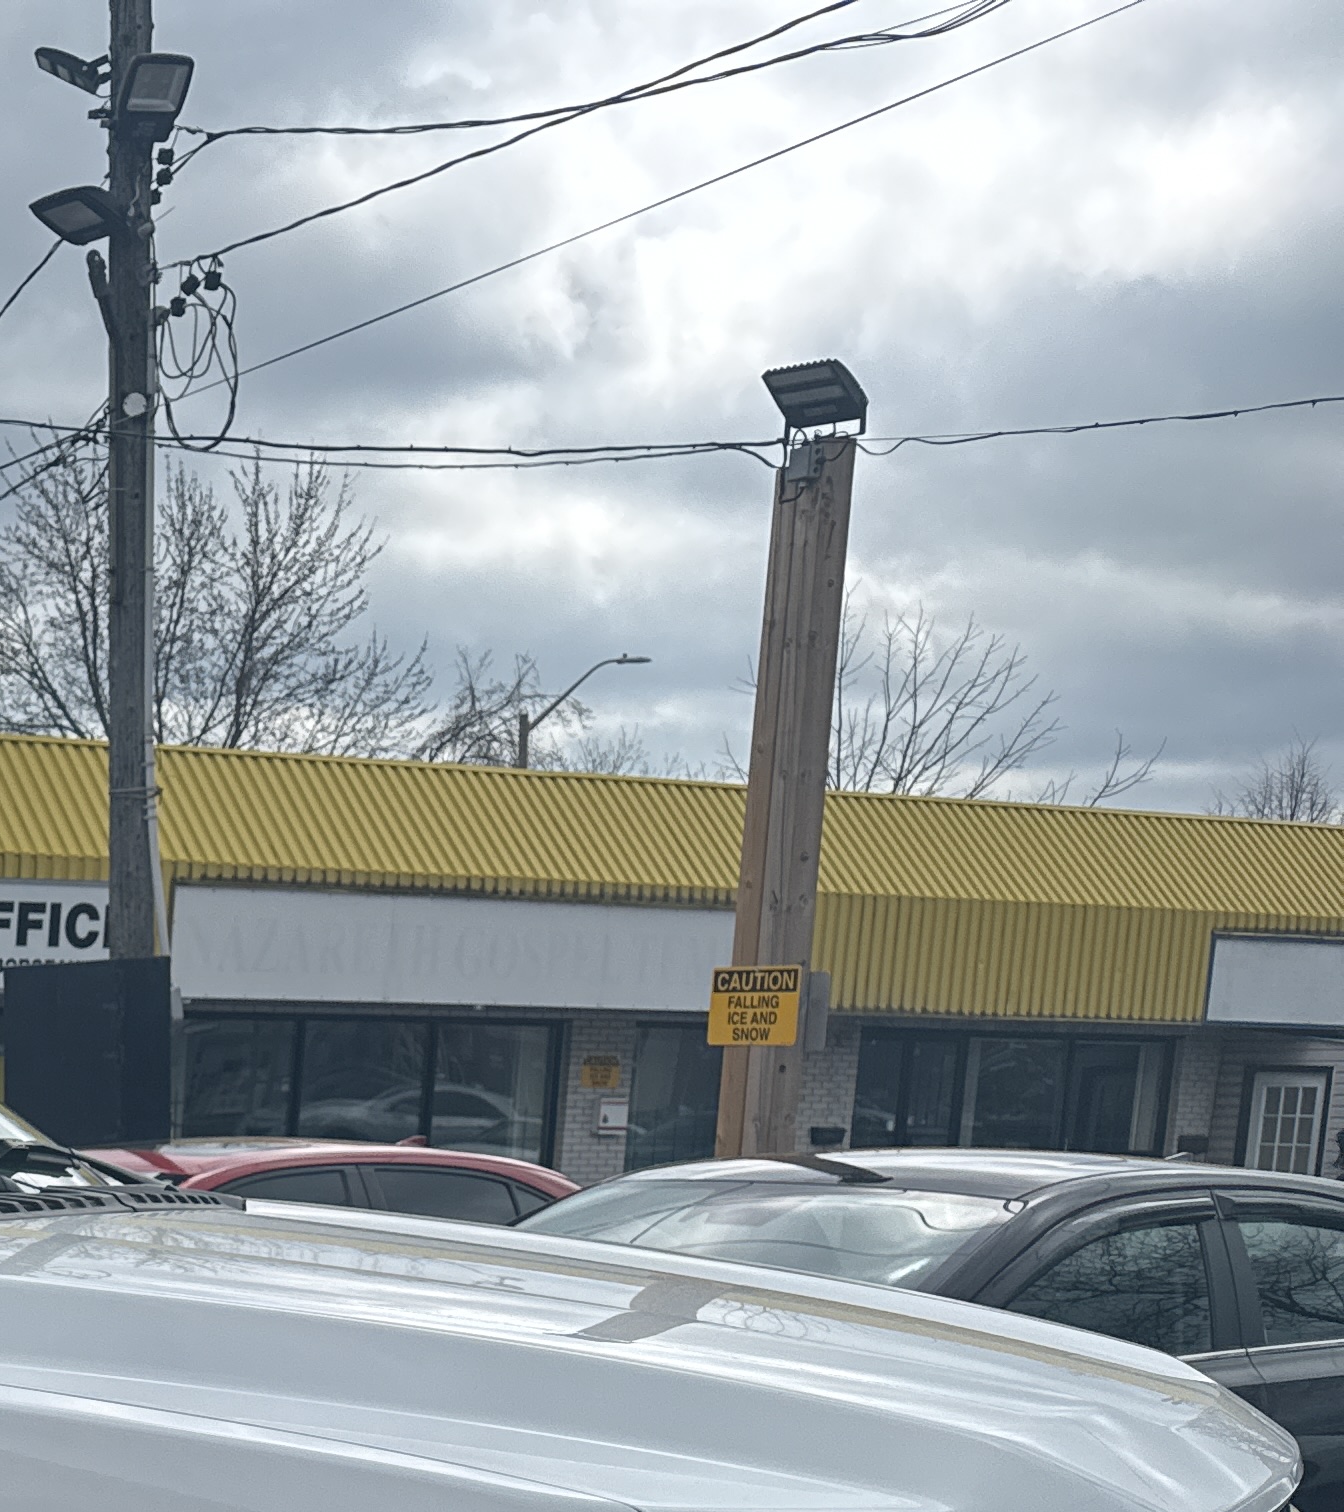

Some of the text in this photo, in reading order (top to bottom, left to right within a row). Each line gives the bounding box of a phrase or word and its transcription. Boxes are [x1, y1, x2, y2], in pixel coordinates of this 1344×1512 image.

[717, 971, 795, 990] CAUTION
[727, 995, 780, 1009] FALLING
[727, 1011, 778, 1025] ICE AND
[732, 1027, 771, 1041] SNOW
